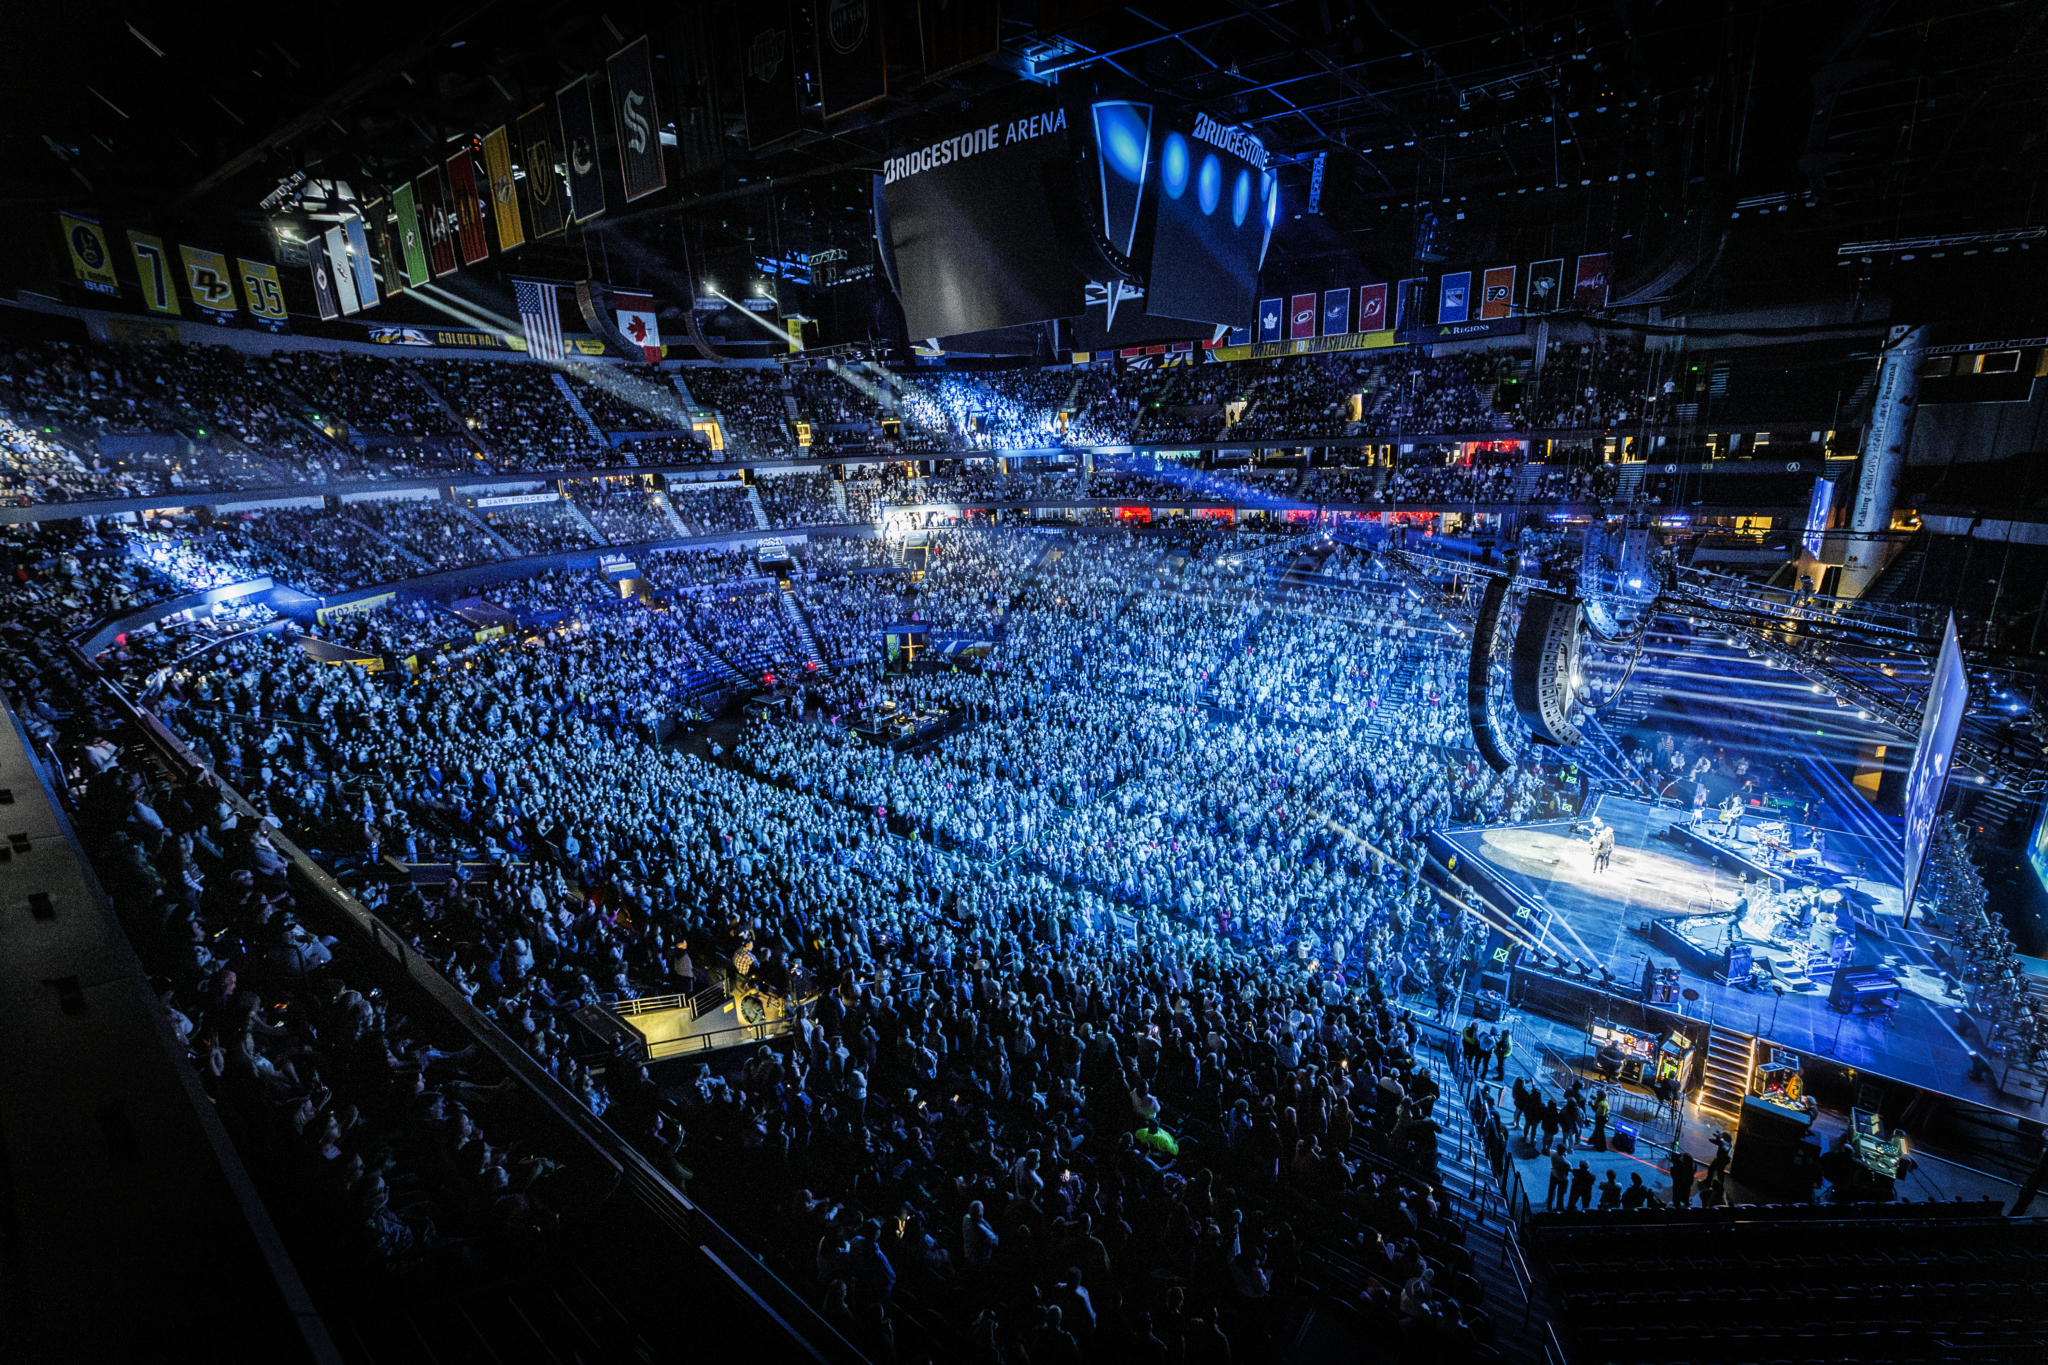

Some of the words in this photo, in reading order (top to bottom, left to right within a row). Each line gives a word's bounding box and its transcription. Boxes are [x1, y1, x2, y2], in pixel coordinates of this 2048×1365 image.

[884, 124, 999, 186] BRIDGESTONE
[1005, 108, 1067, 146] ARENA
[1191, 111, 1270, 171] BRIDGESTONE
[135, 242, 167, 309] 7
[245, 275, 283, 315] 35
[1308, 333, 1366, 352] SMASHVILLE
